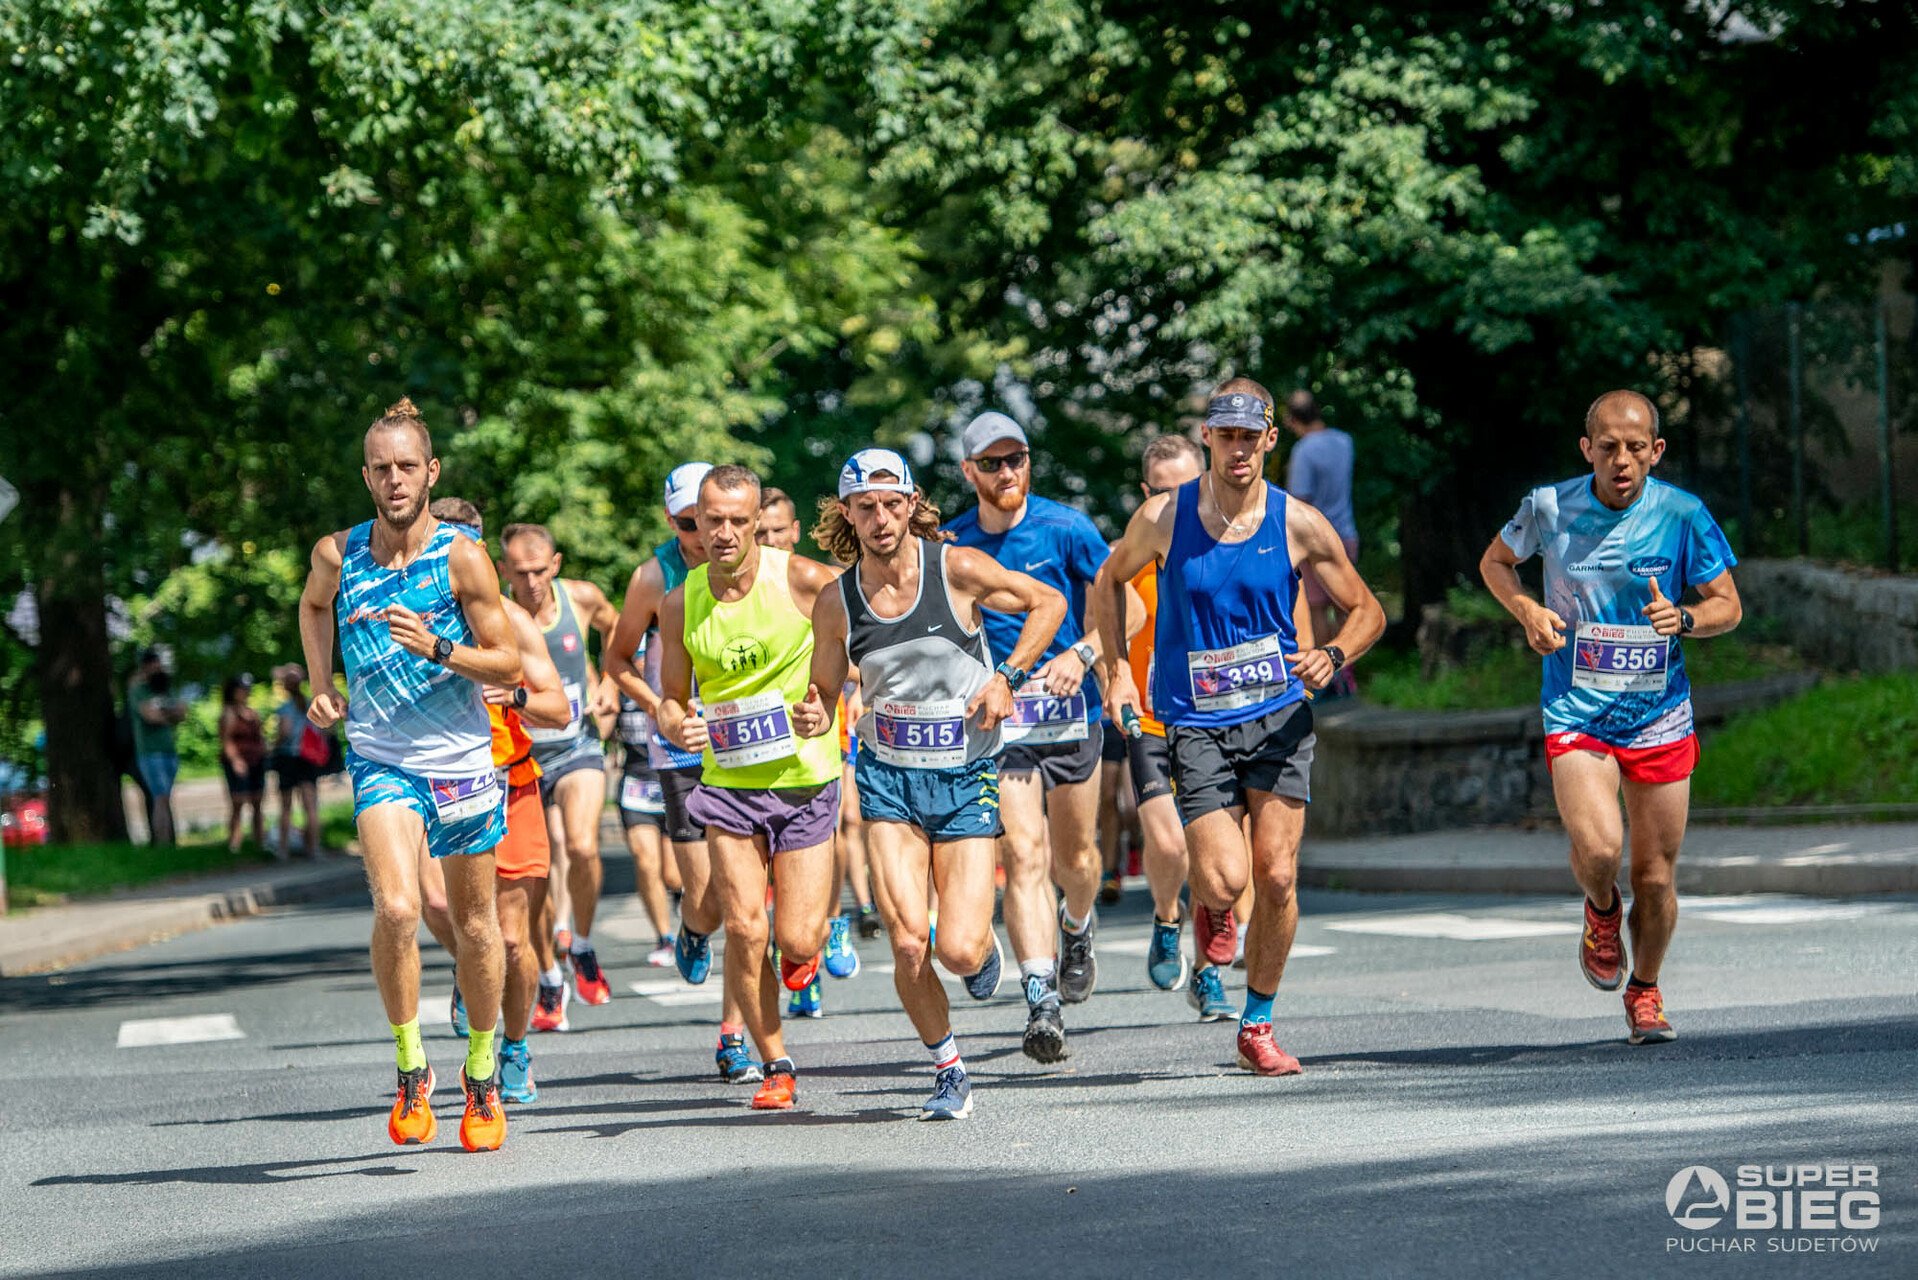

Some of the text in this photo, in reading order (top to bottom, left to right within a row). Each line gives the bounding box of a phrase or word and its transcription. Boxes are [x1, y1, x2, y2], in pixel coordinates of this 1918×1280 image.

[1568, 563, 1604, 572] GARMIN
[1612, 647, 1657, 670] 556
[1228, 661, 1273, 689] 339
[1033, 698, 1073, 721] 121
[736, 715, 777, 744] 511
[907, 724, 954, 747] 515
